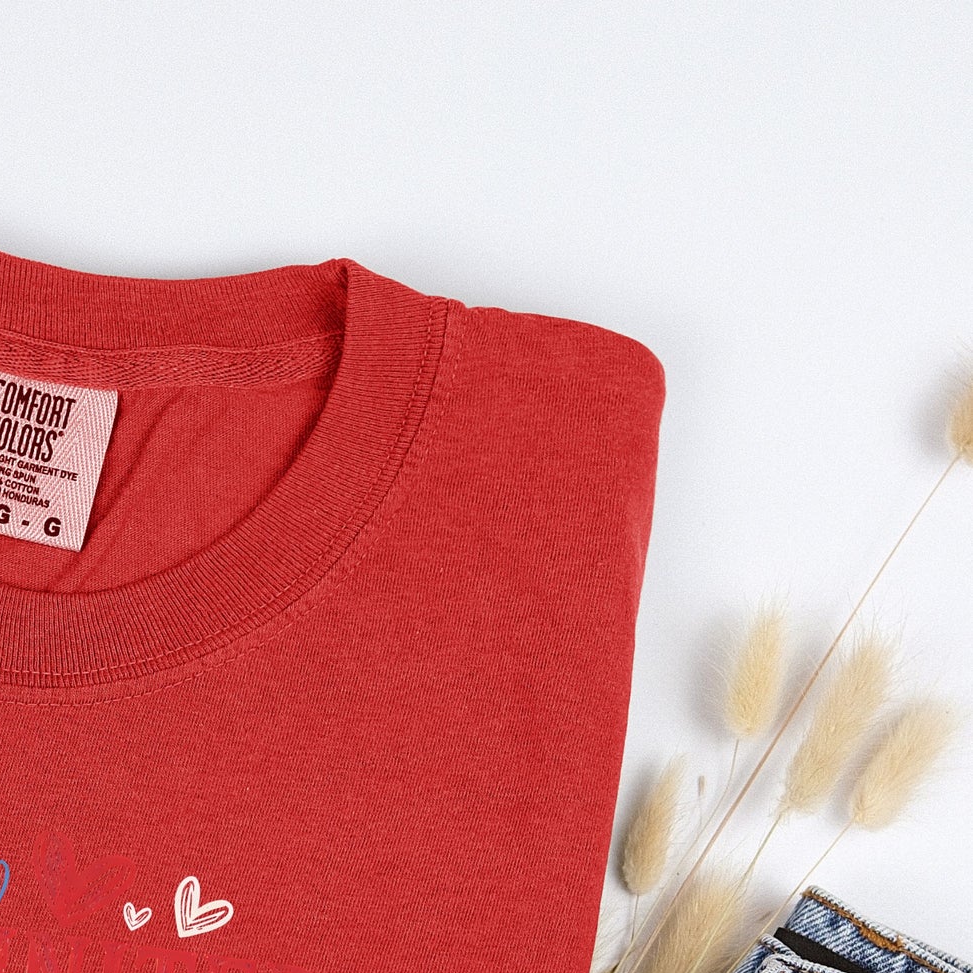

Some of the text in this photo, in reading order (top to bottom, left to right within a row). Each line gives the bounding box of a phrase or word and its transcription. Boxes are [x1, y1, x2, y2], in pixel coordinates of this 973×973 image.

[12, 470, 37, 484] SPUN
[17, 459, 59, 477] GARMENT
[59, 470, 79, 482] DYE
[4, 479, 40, 495] COTTON
[2, 489, 51, 509] HONDURAS
[43, 517, 62, 537] G
